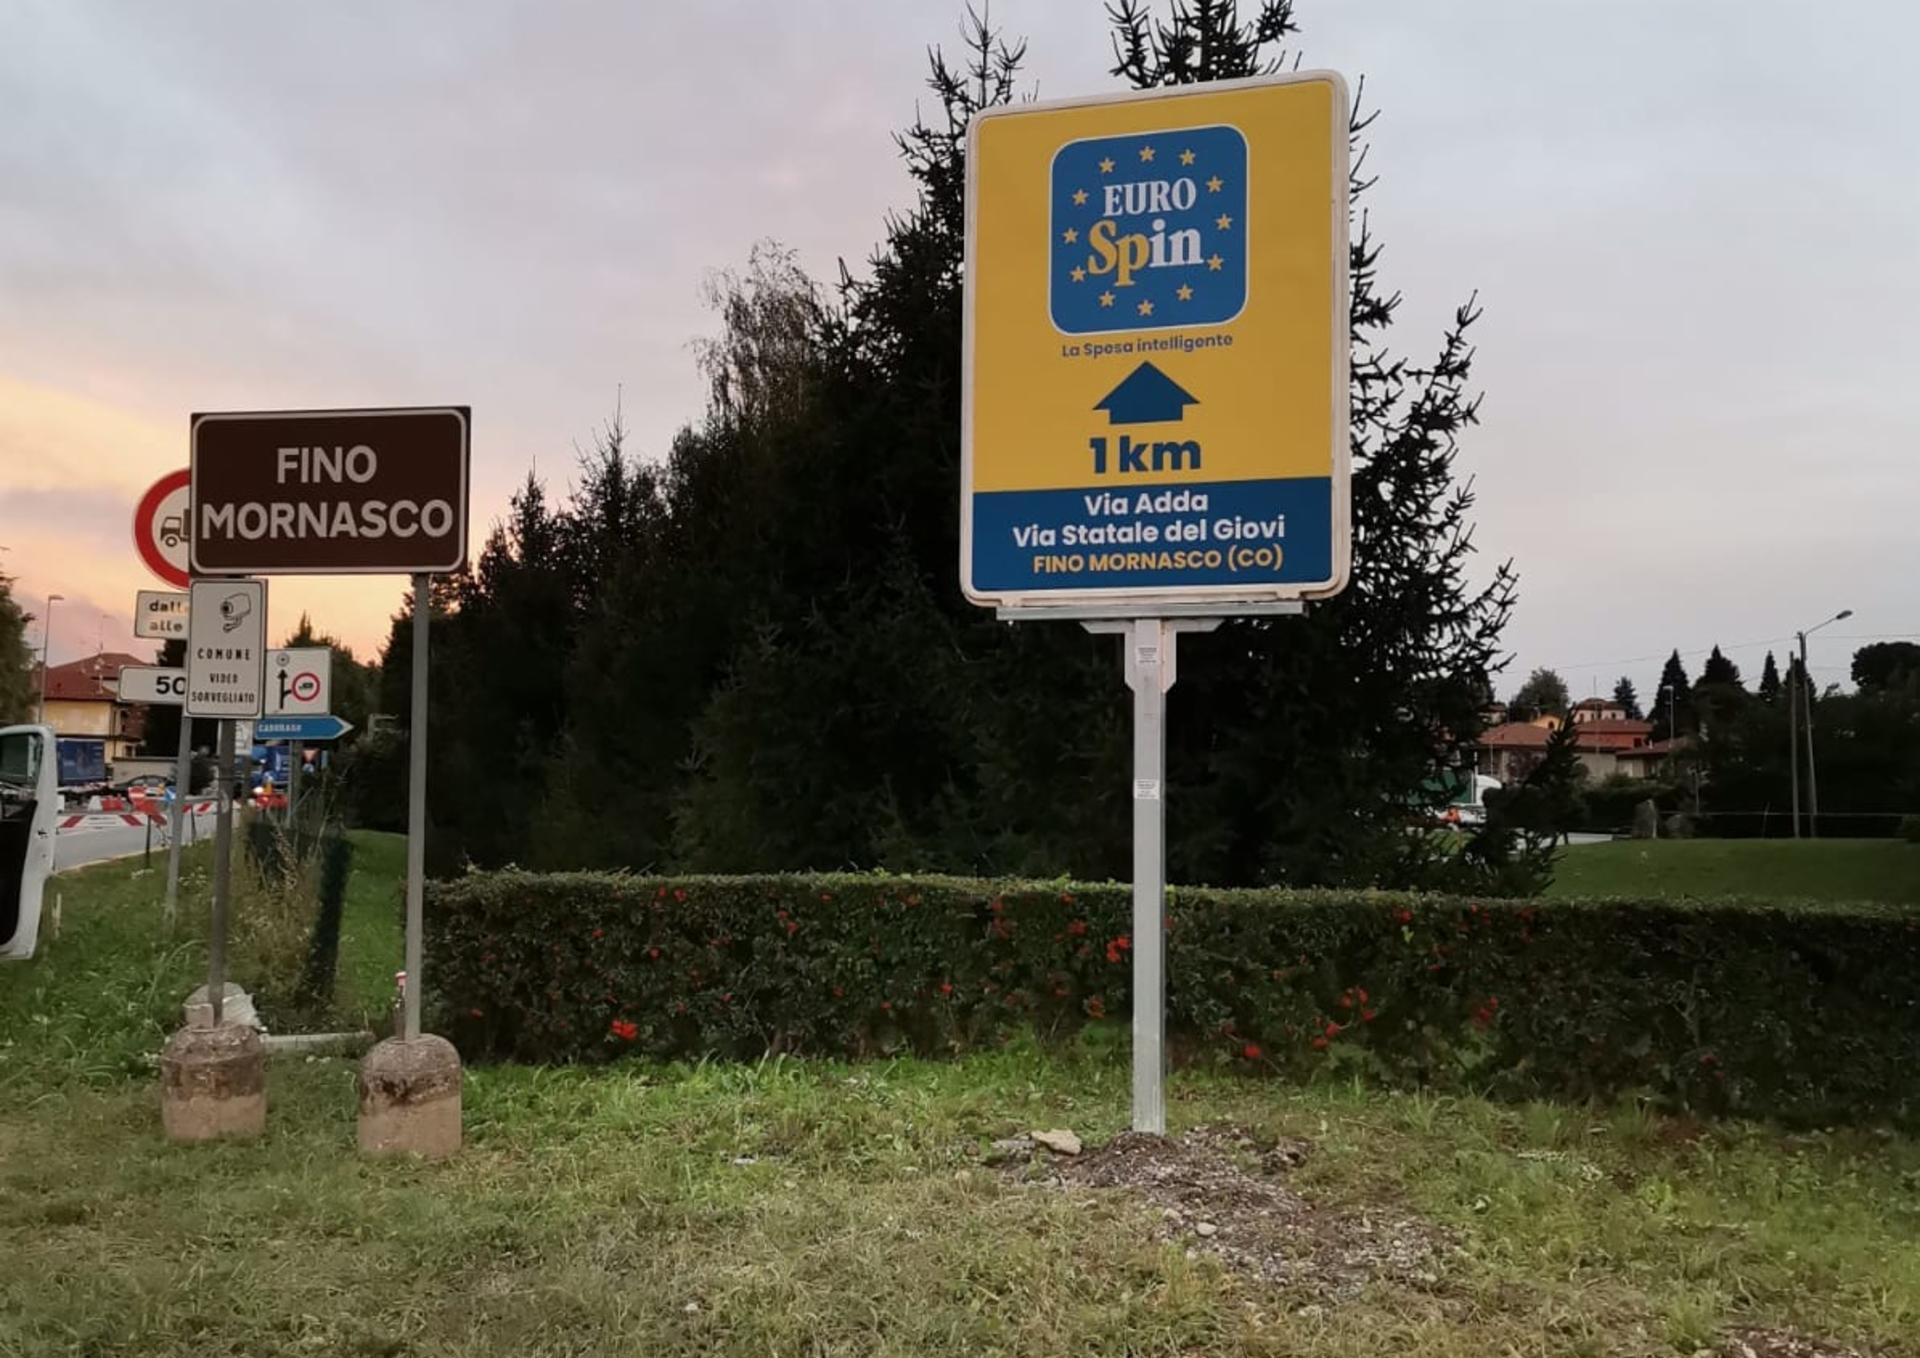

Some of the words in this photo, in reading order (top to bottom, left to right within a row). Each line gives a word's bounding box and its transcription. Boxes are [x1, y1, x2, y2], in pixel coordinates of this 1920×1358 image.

[1102, 177, 1197, 217] EURO
[1087, 218, 1204, 287] Spin
[1062, 344, 1080, 357] La
[1083, 341, 1134, 359] Spesa
[1137, 333, 1233, 353] intelligente
[277, 445, 378, 484] FINO
[1089, 437, 1107, 474] 1
[1119, 435, 1202, 473] km
[1084, 492, 1128, 517] Via
[1135, 489, 1209, 514] Adda
[202, 500, 453, 539] MORNASCO
[1012, 524, 1056, 548] Via
[1061, 520, 1159, 546] Statale
[1213, 514, 1285, 541] Giovi
[1033, 554, 1084, 574] FINO
[1089, 549, 1222, 573] MORNASCO
[1227, 543, 1284, 572] (CO)
[197, 648, 250, 661] COMUNE
[209, 672, 238, 684] VIDEO
[191, 691, 255, 703] SORVEGLIATO
